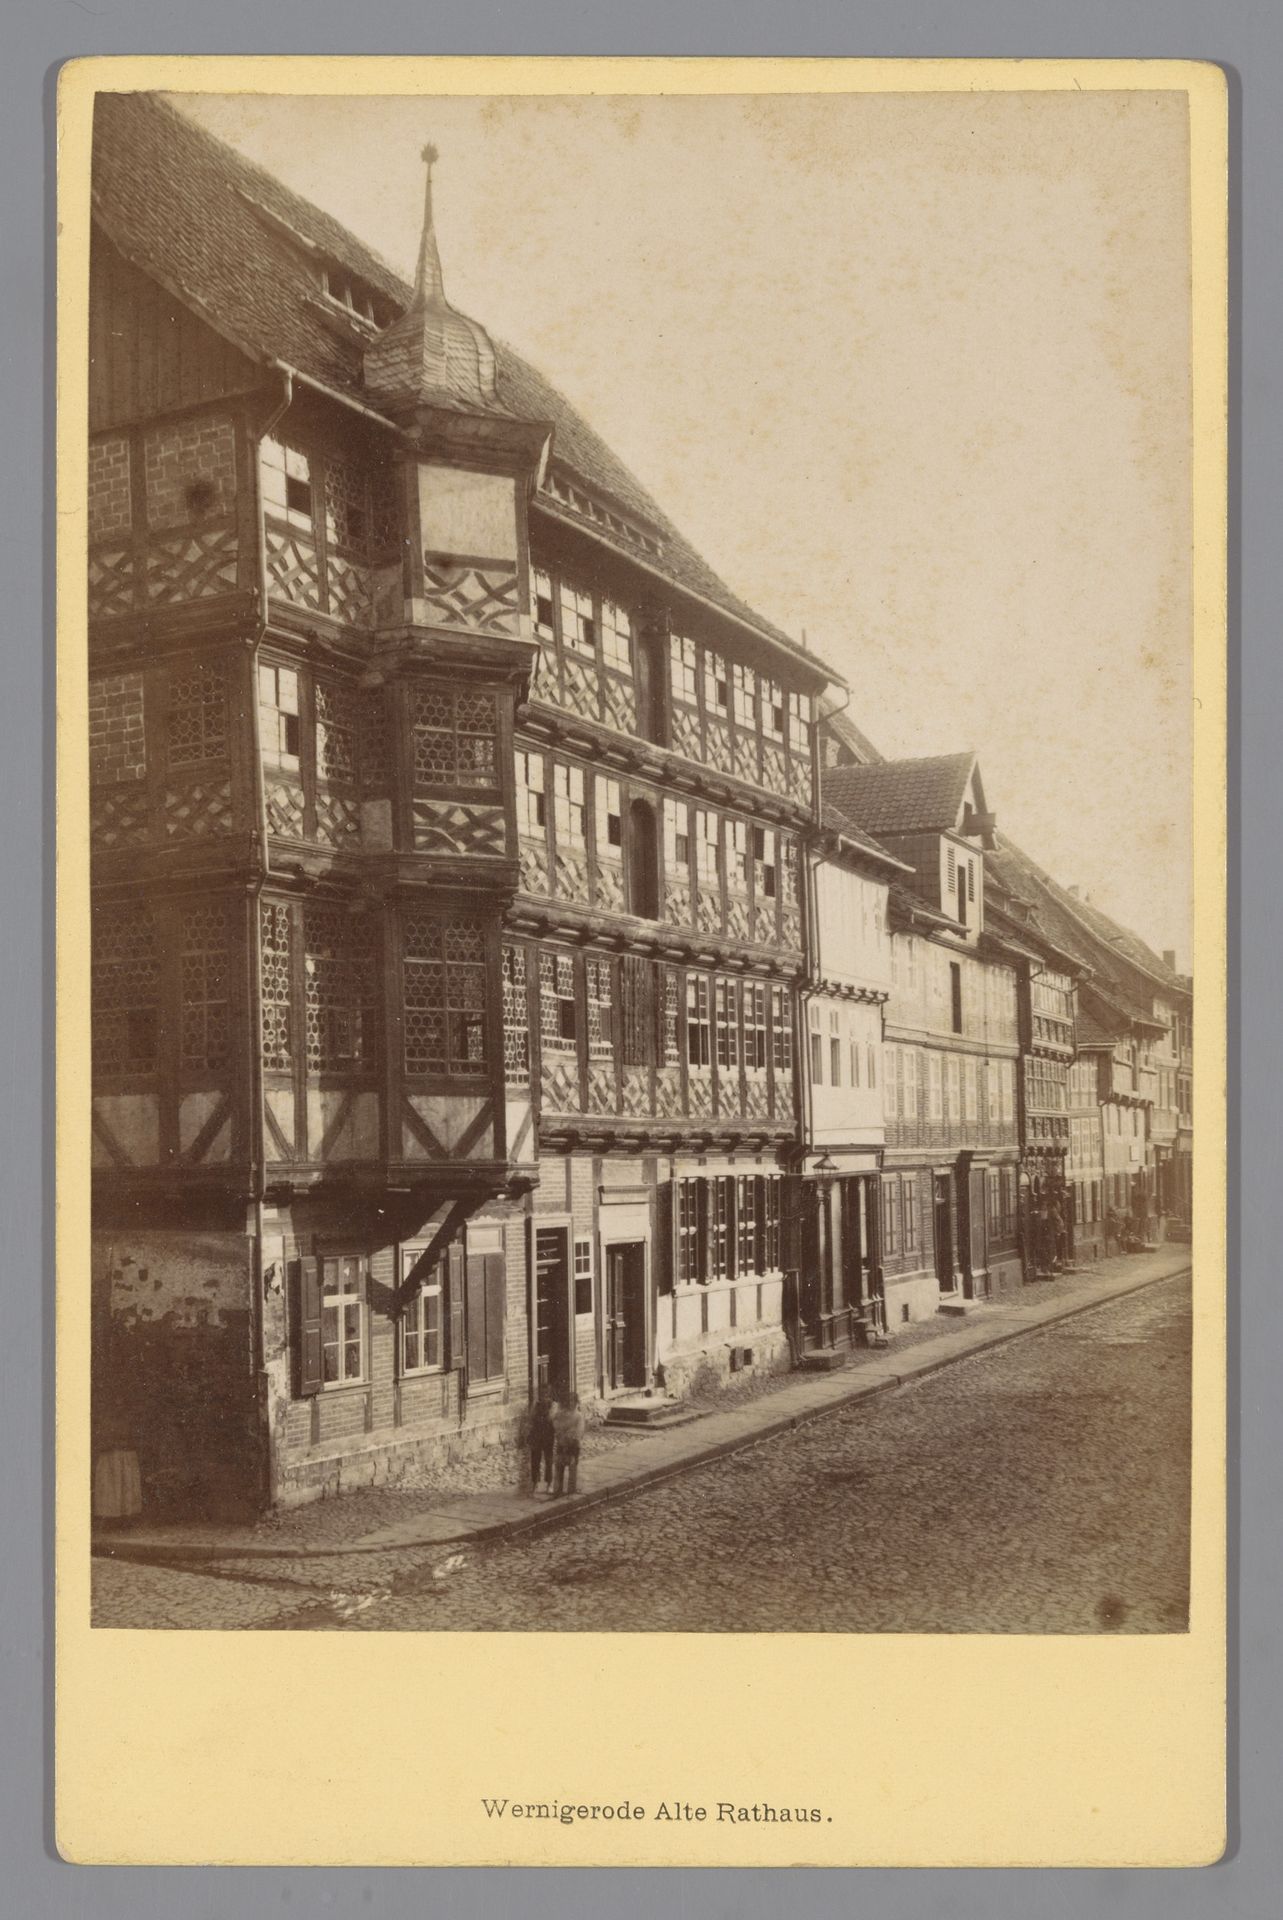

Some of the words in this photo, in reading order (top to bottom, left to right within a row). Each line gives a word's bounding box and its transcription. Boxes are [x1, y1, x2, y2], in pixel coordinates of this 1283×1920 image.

[481, 1799, 645, 1824] Wernigerode
[654, 1801, 707, 1821] Alte
[716, 1803, 833, 1824] Rathaus.
